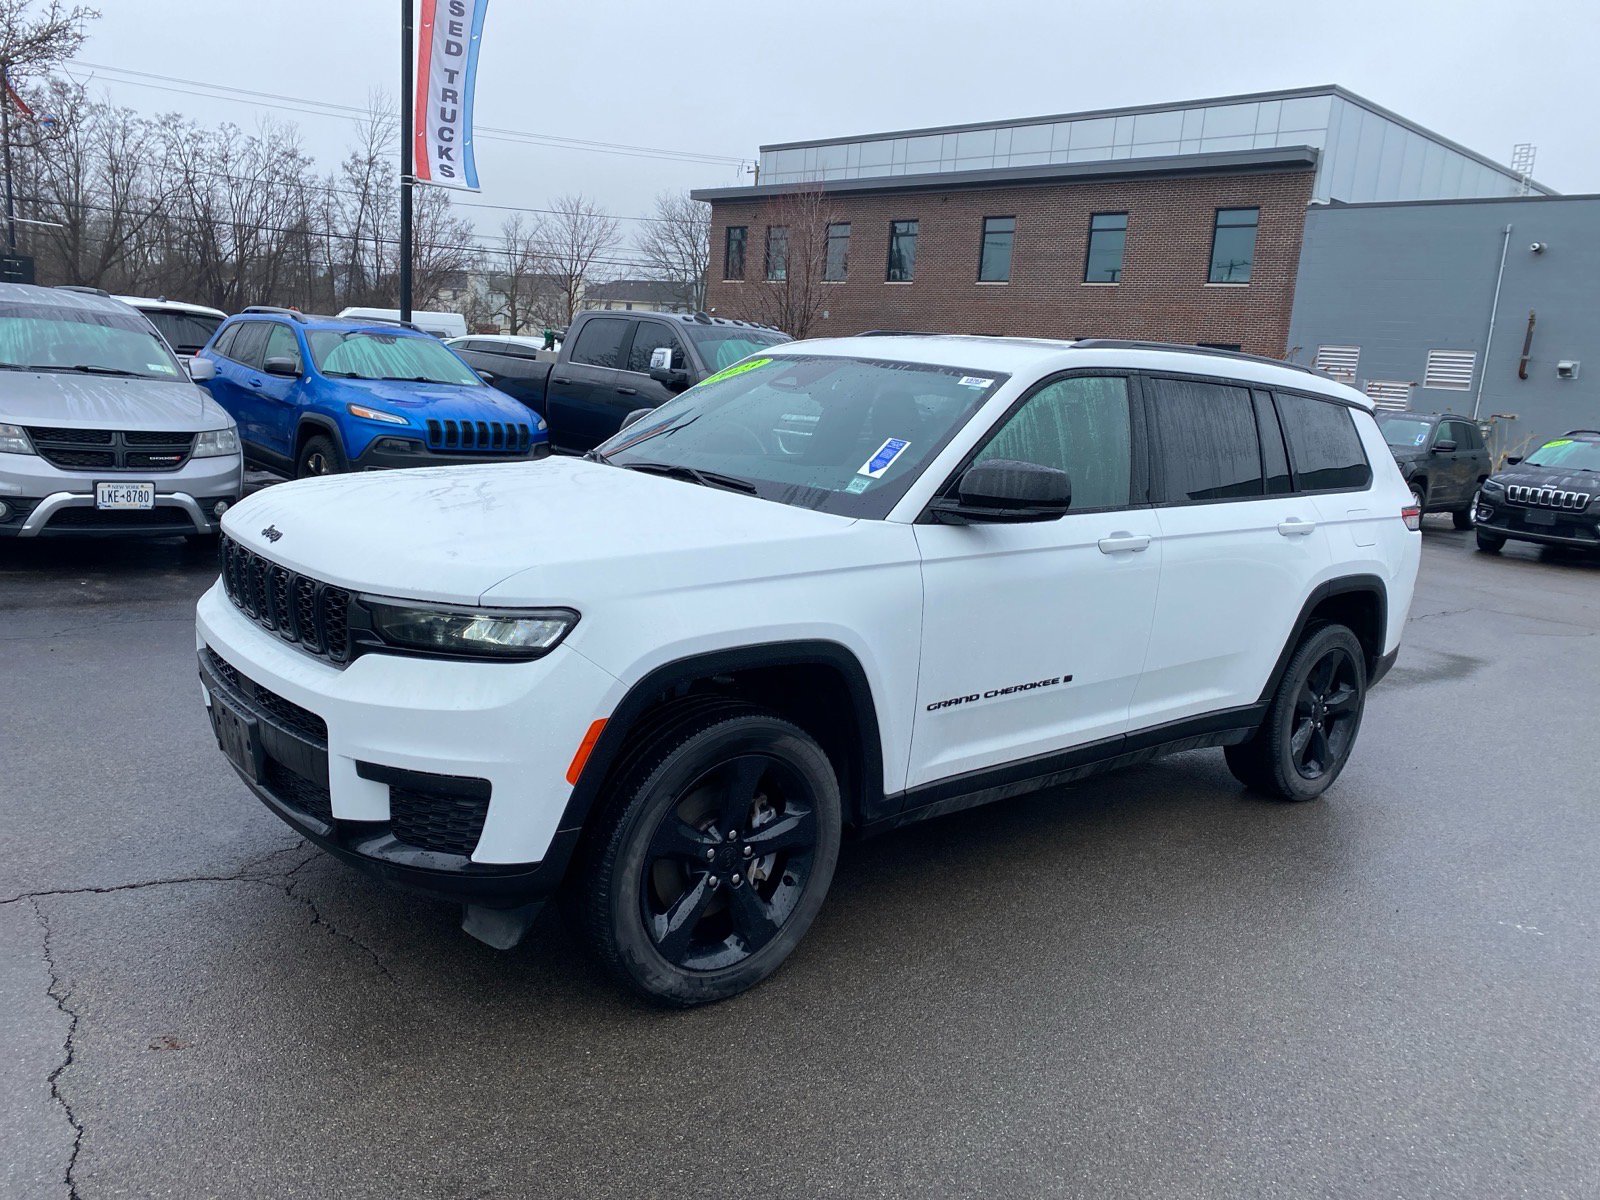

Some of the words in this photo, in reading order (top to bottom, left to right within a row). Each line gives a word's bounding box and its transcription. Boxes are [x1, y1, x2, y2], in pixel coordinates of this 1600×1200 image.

[437, 68, 460, 179] TRUCKS
[261, 524, 284, 544] Jeep
[926, 693, 980, 712] GRAND
[983, 677, 1061, 698] CHEROKEE
